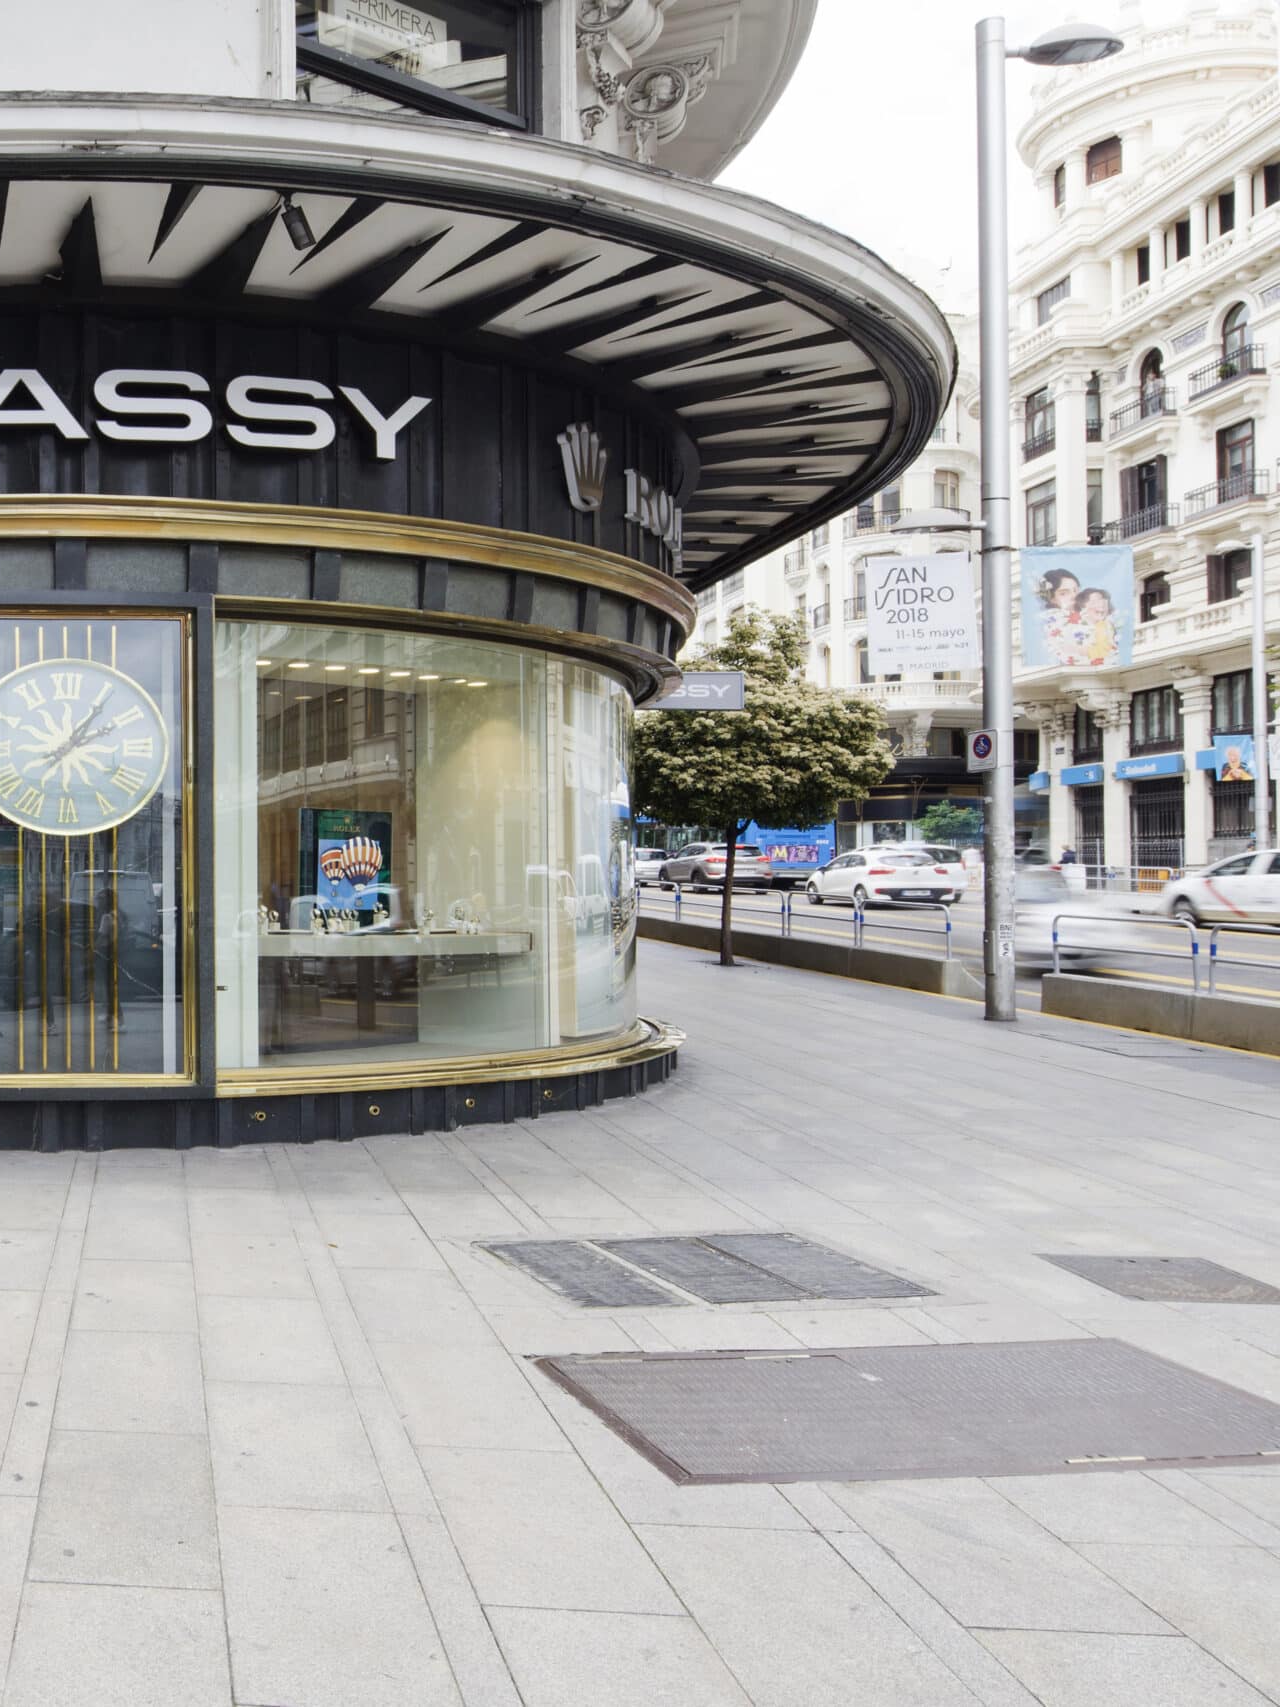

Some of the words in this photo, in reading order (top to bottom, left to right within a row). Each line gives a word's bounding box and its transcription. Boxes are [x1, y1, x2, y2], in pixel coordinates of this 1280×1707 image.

[878, 566, 927, 589] SAN
[874, 586, 955, 610] ISIDRO
[886, 608, 929, 624] 2018
[896, 629, 925, 639] 11-15
[929, 627, 966, 639] mayo
